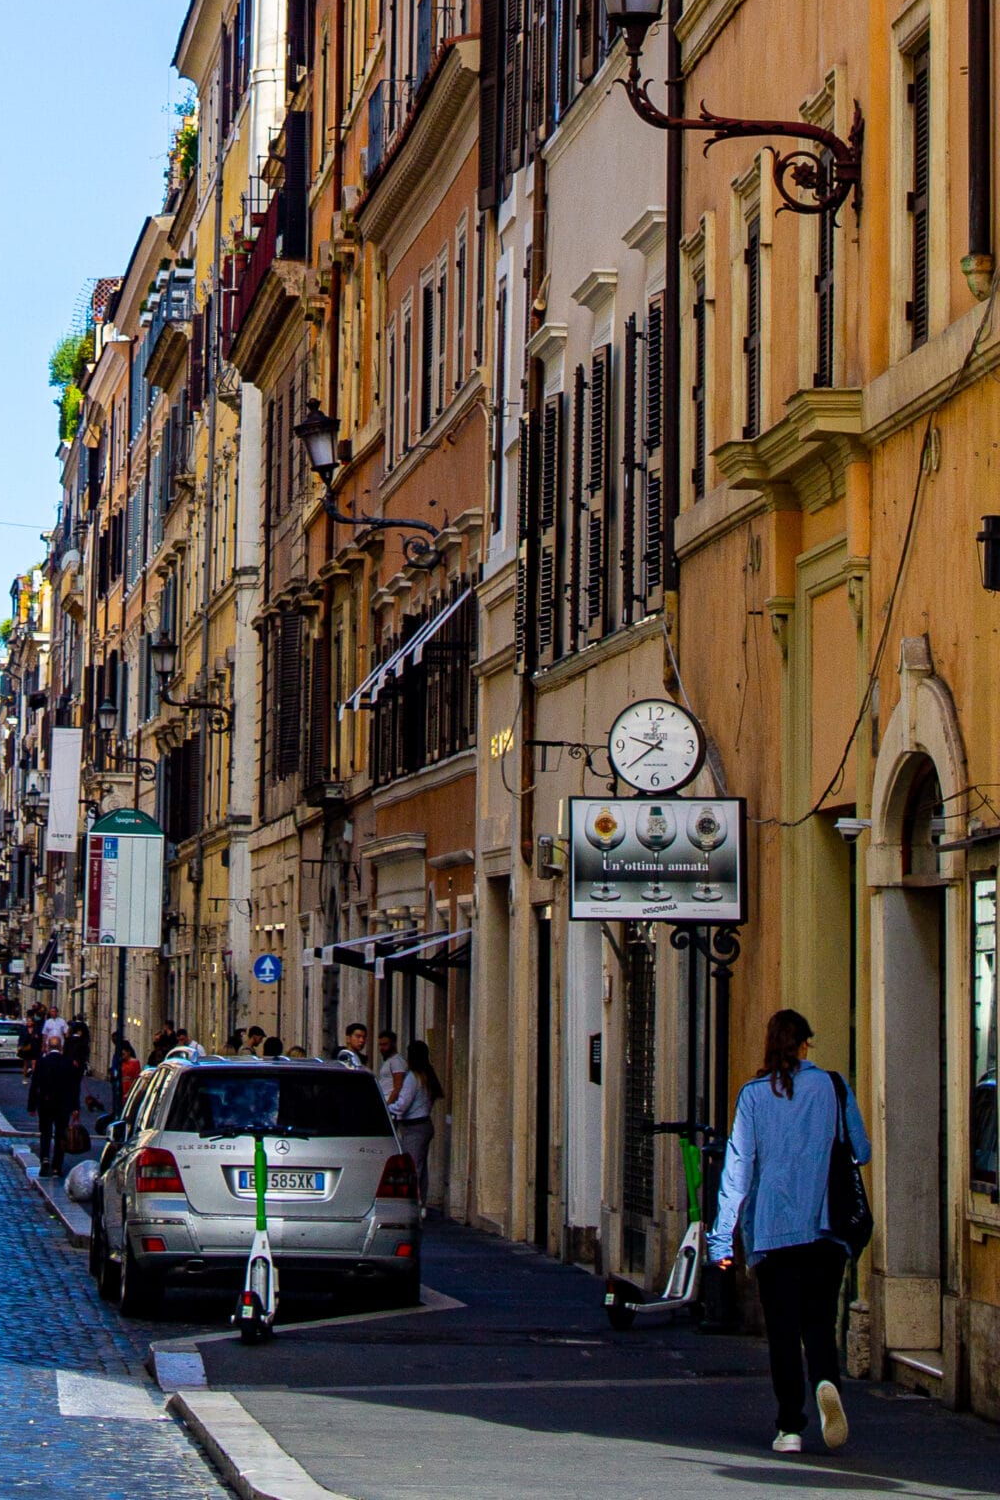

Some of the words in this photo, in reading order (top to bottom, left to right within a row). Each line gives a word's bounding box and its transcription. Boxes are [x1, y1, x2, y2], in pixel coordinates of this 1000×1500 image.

[648, 706, 665, 721] 12
[615, 739, 625, 754] 9
[686, 739, 695, 755] 3
[650, 772, 660, 787] 6
[114, 816, 135, 825] Spagna
[602, 859, 664, 871] Un'ottima
[668, 861, 709, 872] annata
[642, 902, 679, 915] INSOMNIA
[271, 1173, 315, 1189] 585XK
